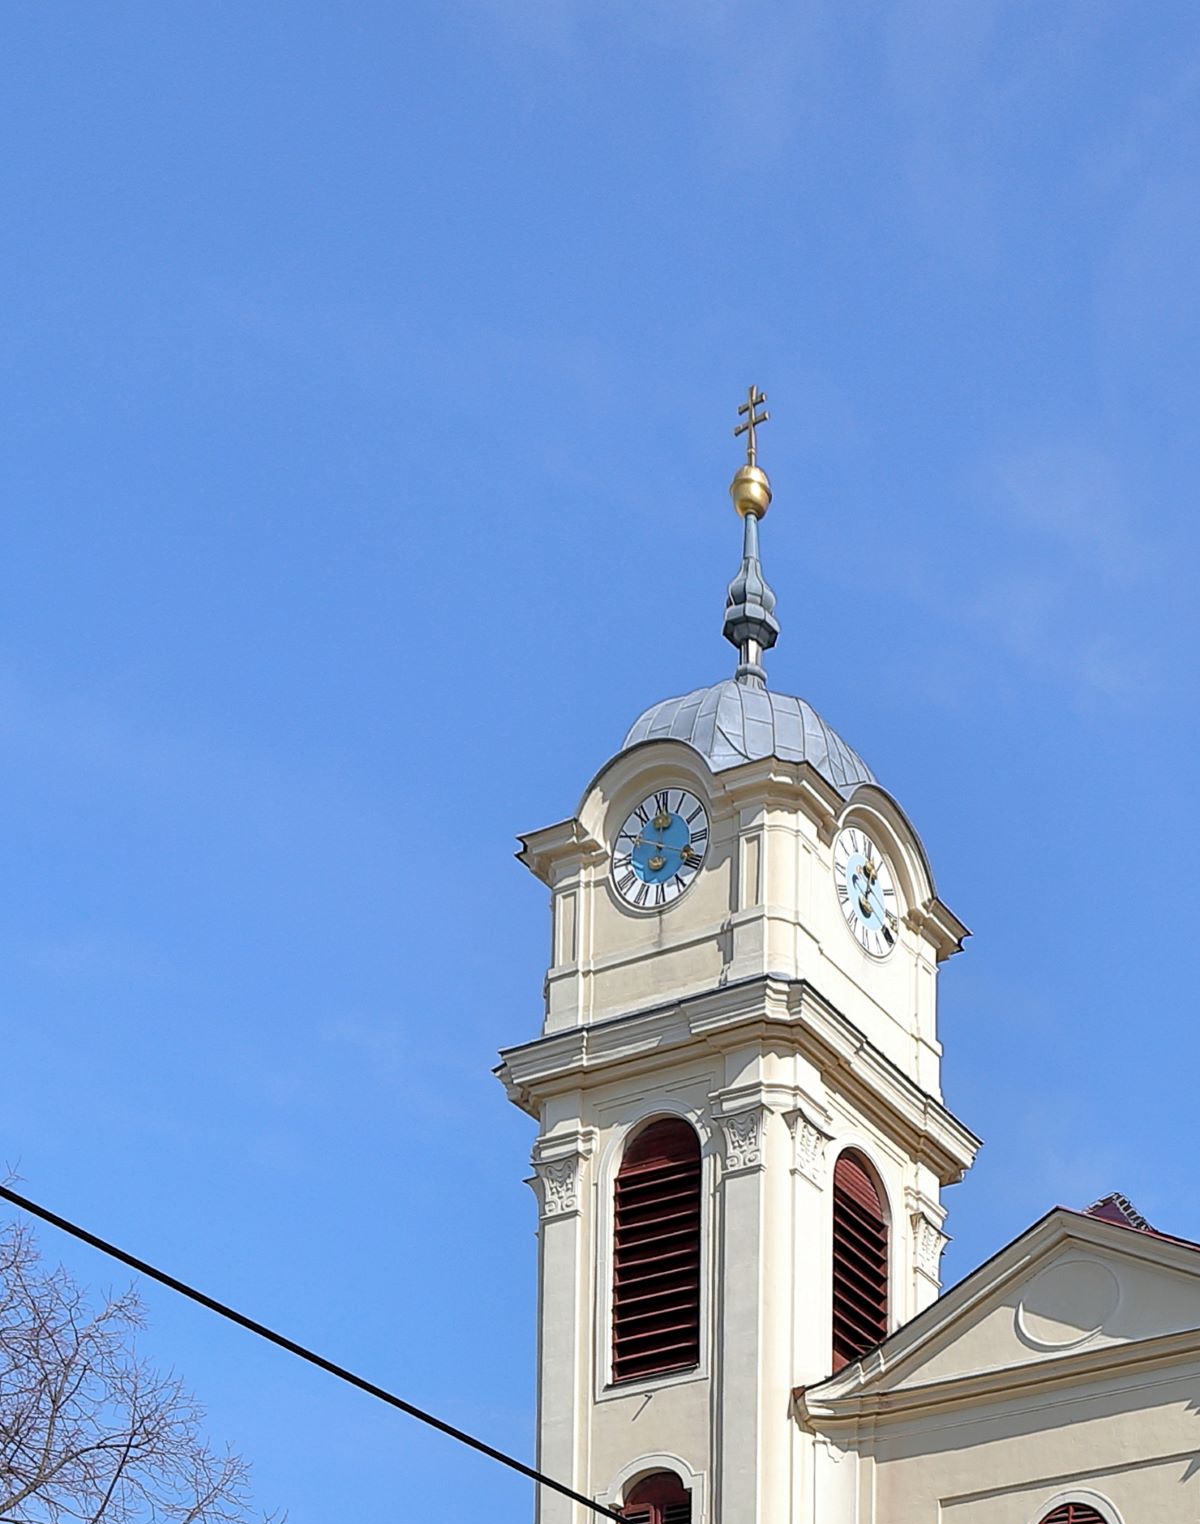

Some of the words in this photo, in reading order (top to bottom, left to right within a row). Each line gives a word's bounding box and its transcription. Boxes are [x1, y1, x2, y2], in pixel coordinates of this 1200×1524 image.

[654, 791, 669, 816] XII
[675, 792, 686, 814] I
[633, 804, 650, 828] XI
[686, 804, 703, 825] II
[619, 828, 638, 844] X
[690, 827, 708, 843] III
[617, 869, 638, 896] VIII
[674, 873, 687, 893] V
[633, 883, 650, 906] VII
[655, 883, 666, 905] VI
